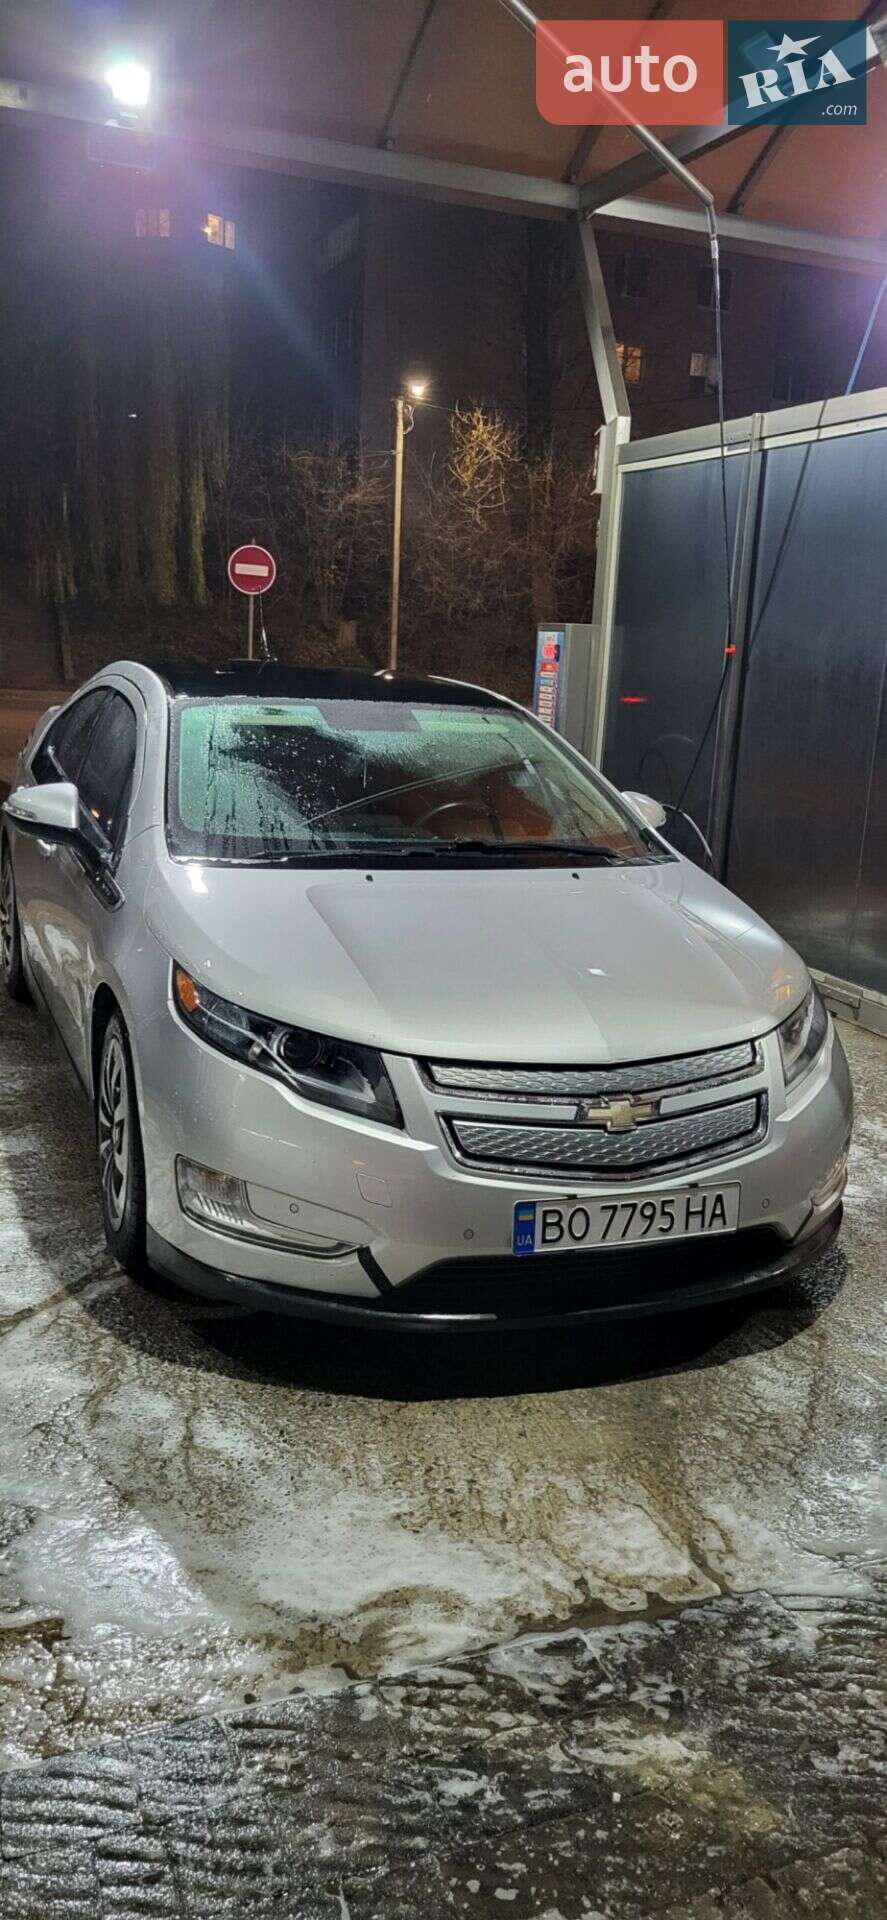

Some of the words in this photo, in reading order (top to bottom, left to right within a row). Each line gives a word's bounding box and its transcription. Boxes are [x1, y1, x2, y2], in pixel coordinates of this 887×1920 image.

[541, 1207, 591, 1244] BO
[600, 1199, 675, 1240] 7795
[685, 1194, 727, 1230] HA
[516, 1234, 533, 1247] UA
